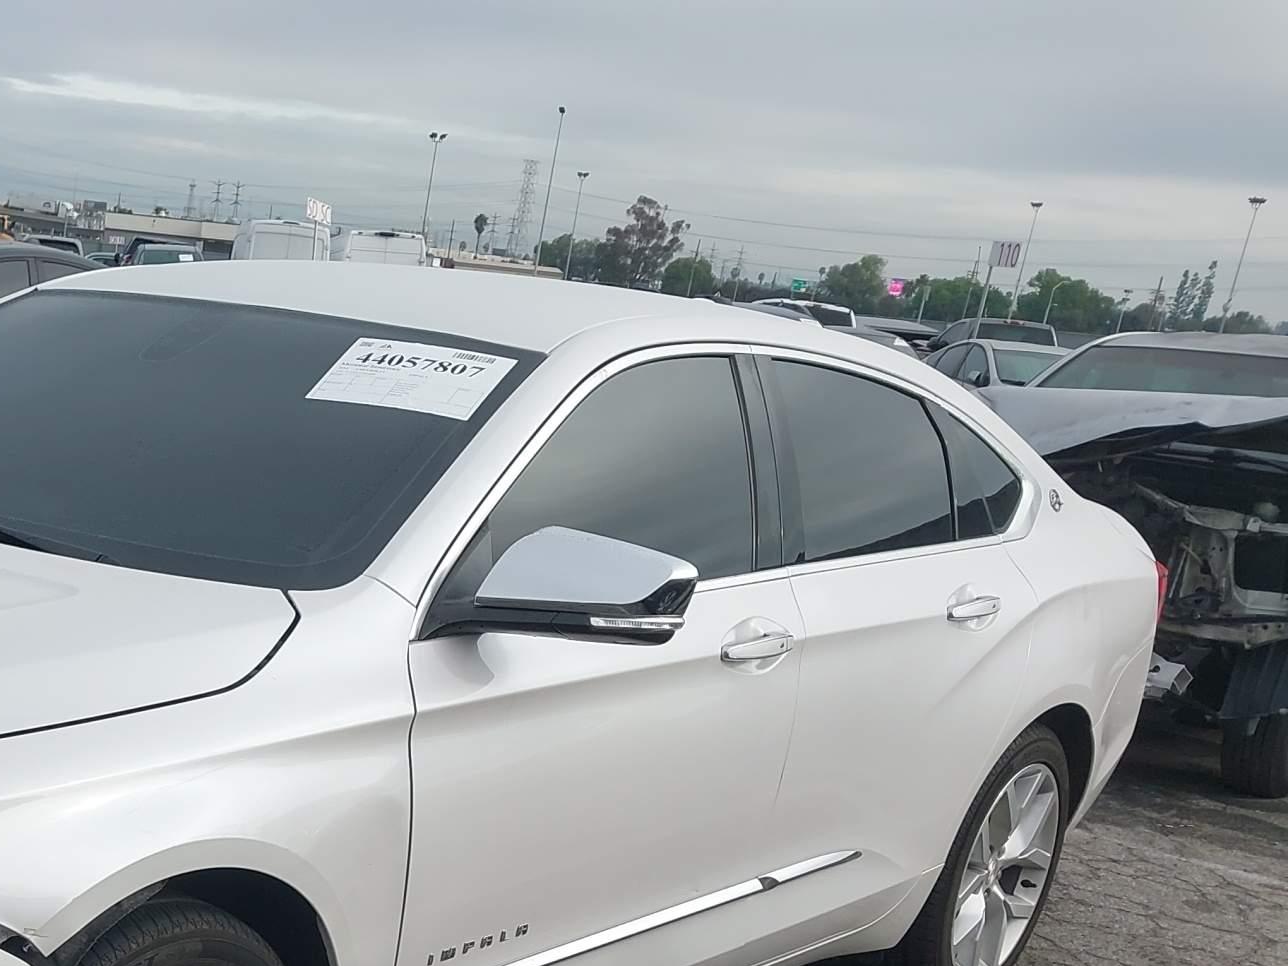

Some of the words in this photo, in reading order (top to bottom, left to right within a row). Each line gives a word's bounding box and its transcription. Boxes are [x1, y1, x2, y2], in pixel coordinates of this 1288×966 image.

[998, 243, 1020, 267] 110
[355, 351, 487, 378] 44057807
[426, 924, 530, 966] IMPALA
